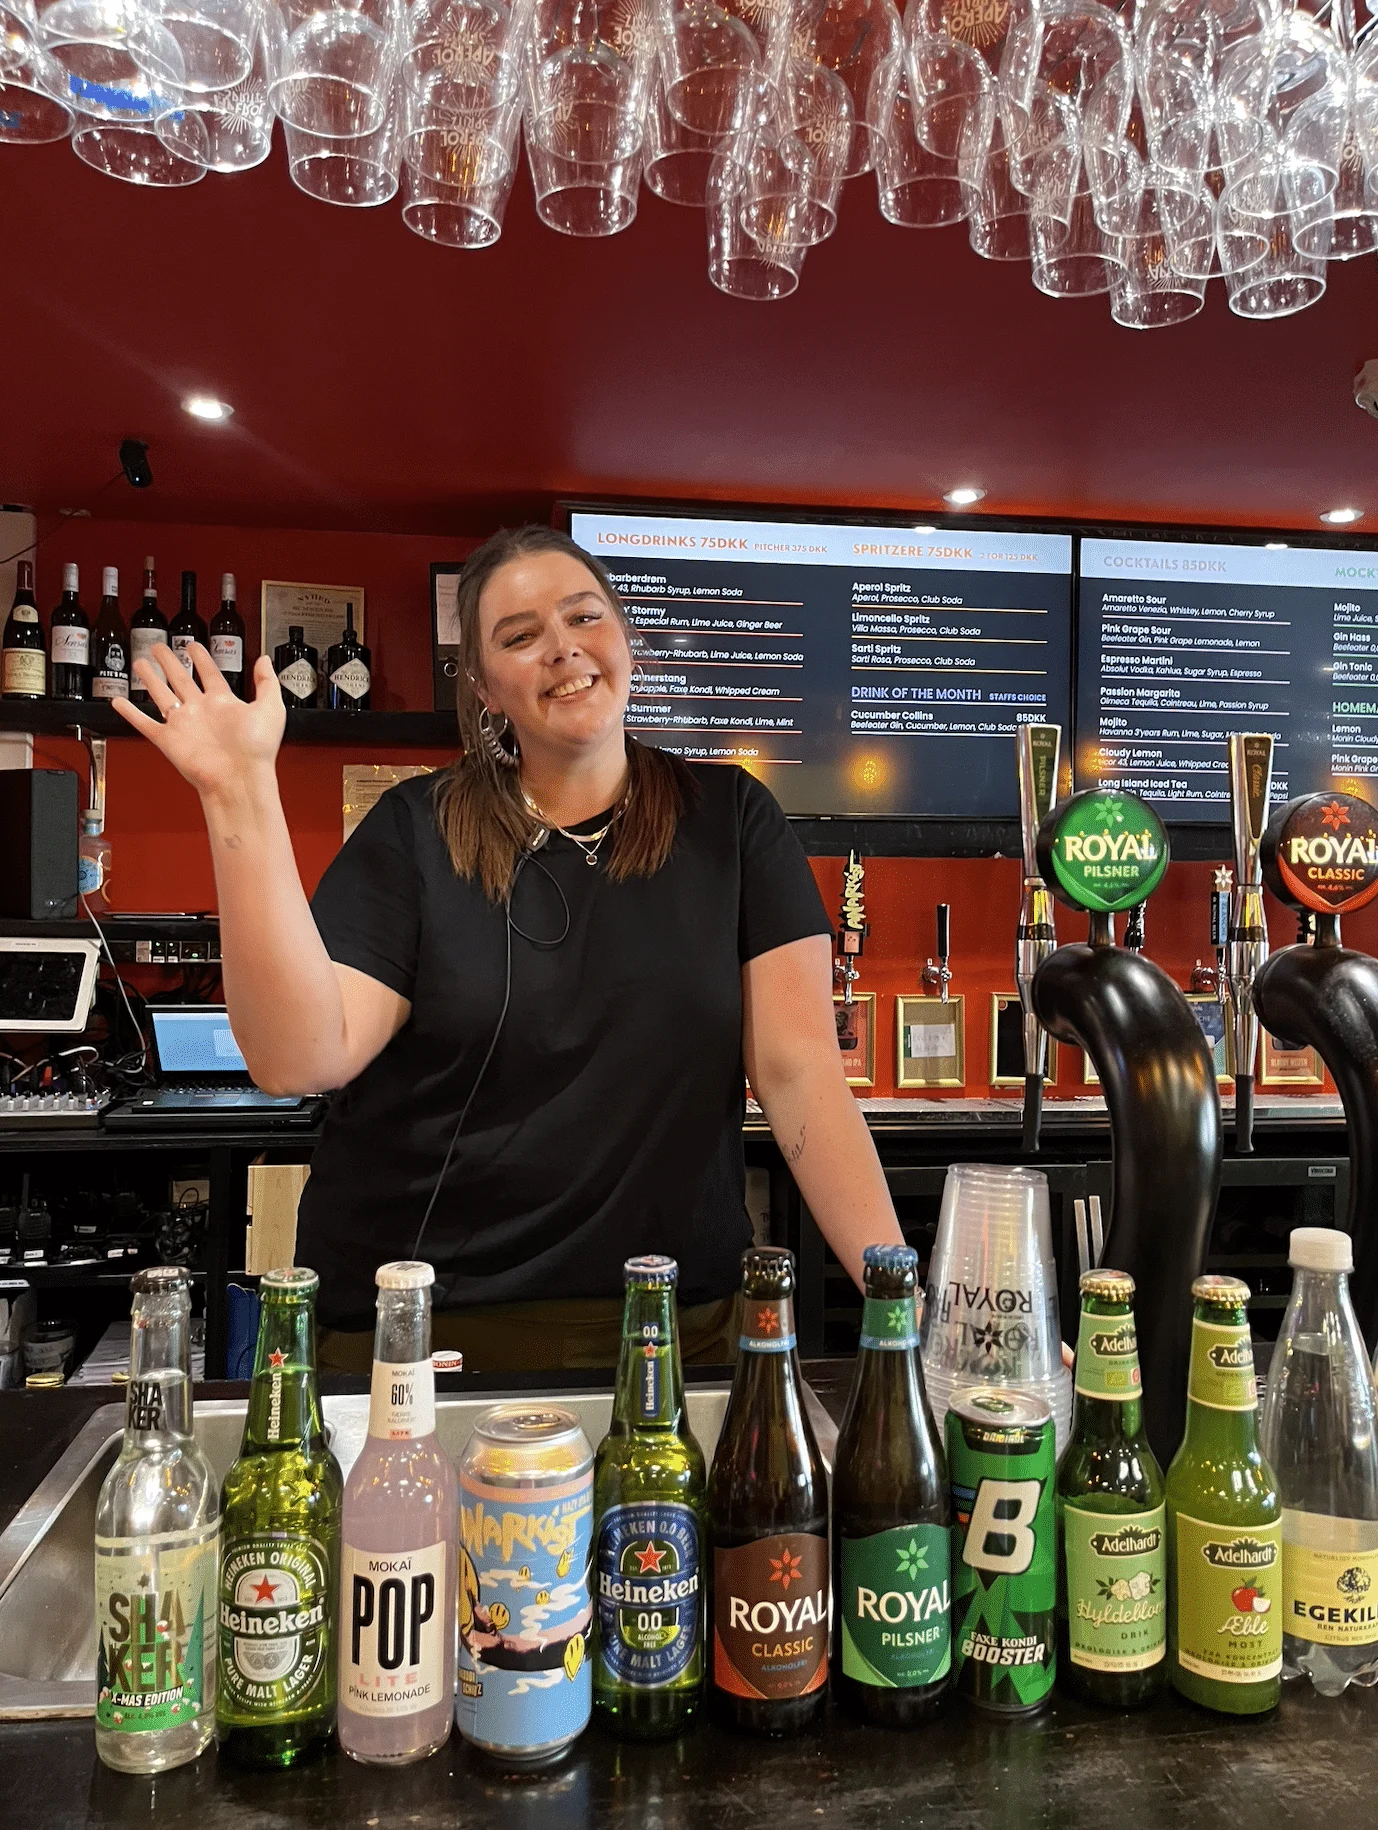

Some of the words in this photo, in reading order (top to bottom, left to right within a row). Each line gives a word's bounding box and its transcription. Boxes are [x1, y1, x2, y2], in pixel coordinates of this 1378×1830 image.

[597, 532, 696, 548] LONGDRINKS
[700, 537, 748, 550] 75DKK
[754, 543, 790, 552] PITCHER
[792, 544, 807, 552] 375
[808, 545, 828, 553] DKK
[853, 543, 923, 557] SPRITZERE
[927, 546, 973, 559] 75DKK
[1103, 555, 1178, 570] COCKTAILS
[1182, 559, 1227, 572] 85DKK
[630, 584, 666, 594] Rhubarb
[667, 585, 691, 596] Syrup,
[693, 587, 720, 596] Lemon
[721, 587, 743, 597] Soda
[852, 582, 883, 594] Aperol
[884, 583, 912, 594] Spritz
[851, 593, 879, 603] Aperol,
[881, 594, 920, 604] Prosecco,
[921, 595, 940, 604] Club
[942, 596, 963, 605] Soda
[1102, 593, 1145, 604] Amaretto
[1146, 595, 1167, 605] Sour
[631, 605, 667, 618] Stormy
[1334, 602, 1361, 614] Mojito
[635, 616, 669, 627] Especial
[670, 617, 690, 627] Rum,
[691, 618, 711, 628] Lime
[712, 619, 734, 628] Juice,
[736, 619, 763, 630] Ginger
[764, 620, 783, 629] Beer
[851, 612, 903, 623] Limoncello
[903, 614, 931, 626] Spritz
[1333, 613, 1351, 622] Lime
[1352, 614, 1373, 623] Juice,
[851, 624, 868, 633] Villa
[869, 625, 898, 634] Massa,
[899, 625, 938, 635] Prosecco,
[939, 626, 959, 635] Club
[959, 627, 981, 636] Soda
[1101, 623, 1121, 633] Pink
[1121, 624, 1150, 636] Grape
[1150, 626, 1172, 635] Sour
[1333, 632, 1349, 642] Gin
[1349, 633, 1371, 642] Hass
[851, 643, 874, 653] Sarti
[875, 644, 902, 656] Spritz
[1333, 643, 1369, 652] Beefeater
[851, 655, 870, 664] Sarti
[871, 655, 893, 665] Rosa,
[893, 656, 932, 666] Prosecco,
[934, 656, 954, 666] Club
[954, 657, 976, 667] Soda
[1100, 654, 1141, 665] Espresso
[1141, 655, 1173, 666] Martini
[1333, 661, 1348, 671] Gin
[1349, 662, 1373, 672] Tonic
[1332, 672, 1369, 681] Beefeater
[851, 686, 889, 699] DRINK
[892, 687, 909, 699] OF
[911, 688, 934, 700] THE
[936, 688, 982, 701] MONTH
[989, 693, 1016, 702] STAFFS
[1018, 693, 1046, 702] CHOICE
[1100, 687, 1135, 697] Passion
[1136, 688, 1180, 699] Margarita
[631, 703, 672, 713] Summer
[851, 710, 901, 721] Cucumber
[901, 711, 934, 722] Collins
[1016, 713, 1046, 723] 85DKK
[1099, 717, 1128, 728] Mojito
[1332, 724, 1361, 733] Lemon
[684, 746, 708, 757] Syrup,
[709, 747, 736, 756] Lemon
[738, 747, 759, 756] Soda
[1098, 747, 1131, 759] Cloudy
[1132, 748, 1163, 758] Lemon
[1331, 753, 1350, 764] Pink
[1351, 754, 1378, 765] Grape
[1331, 764, 1353, 772] Monin
[1354, 764, 1368, 772] Pink
[1098, 778, 1120, 789] Long
[1121, 779, 1149, 788] Island
[1150, 779, 1170, 789] Iced
[1171, 780, 1188, 789] Tea
[1064, 833, 1158, 861] ROYAL
[1290, 836, 1378, 865] ROYAL
[1083, 865, 1140, 878] PILSNER
[1307, 866, 1365, 880] CLASSIC
[949, 1281, 1033, 1314] ROYAL
[391, 1368, 415, 1377] MOKAÏ
[129, 1381, 163, 1406] SHA
[645, 1360, 655, 1411] Heineken
[391, 1383, 414, 1406] 60%
[266, 1372, 282, 1440] Heineken
[128, 1404, 161, 1431] KER
[660, 1520, 677, 1535] 0.0
[962, 1478, 1042, 1575] B
[1102, 1531, 1157, 1552] Adelhardt
[1214, 1546, 1272, 1565] Adelhardt
[224, 1551, 265, 1591] HEINEKEN
[270, 1551, 317, 1590] ORIGINAL
[368, 1556, 412, 1573] MOKAÏ
[599, 1571, 699, 1603] Heineken
[857, 1579, 951, 1624] ROYAL
[109, 1588, 186, 1644] SHA
[220, 1600, 324, 1635] Heineken
[730, 1589, 827, 1634] ROYAL
[1294, 1599, 1378, 1624] EGEKIL
[352, 1572, 435, 1670] POP
[637, 1611, 663, 1632] 0.0
[1217, 1615, 1269, 1636] Æble
[881, 1626, 940, 1647] PILSNER
[970, 1631, 999, 1648] FAXE
[1001, 1633, 1037, 1648] KONDI
[1121, 1629, 1149, 1640] DRIK
[630, 1653, 662, 1669] MALT
[666, 1625, 692, 1662] LAGER
[643, 1641, 657, 1649] FREE
[751, 1636, 814, 1658] CLASSIC
[961, 1639, 1046, 1666] BOOSTER
[1228, 1640, 1263, 1649] MOST
[108, 1640, 184, 1692] KER
[224, 1657, 244, 1690] PURE
[245, 1684, 278, 1699] MALT
[282, 1654, 314, 1693] LAGER
[359, 1672, 418, 1688] LITE
[111, 1693, 142, 1707] X-MAS
[144, 1685, 184, 1706] EDITION
[371, 1683, 431, 1702] LEMONADE
